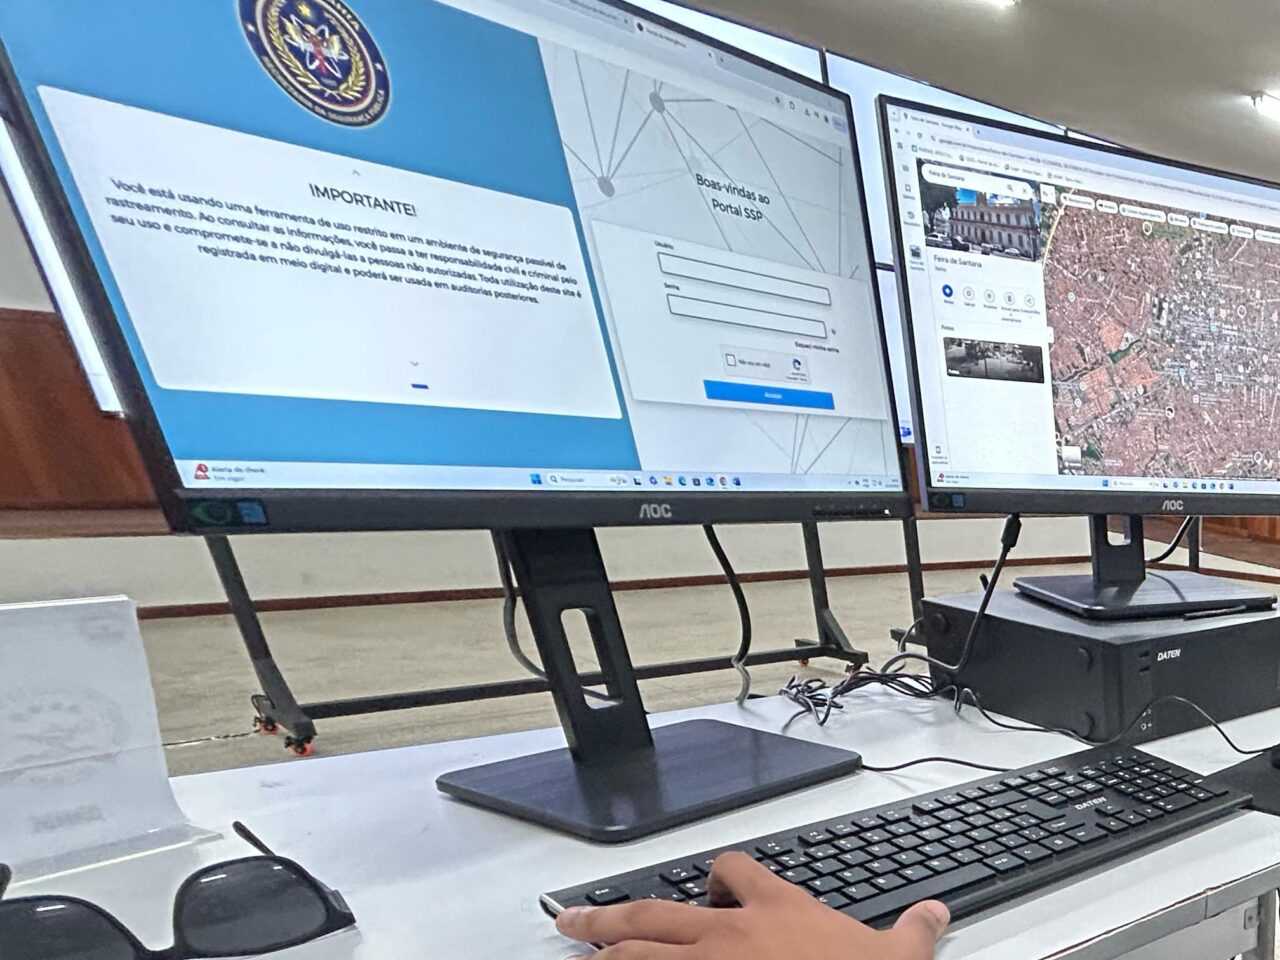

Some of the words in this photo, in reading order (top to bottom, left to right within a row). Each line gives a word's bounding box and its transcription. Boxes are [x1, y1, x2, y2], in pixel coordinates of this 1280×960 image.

[695, 172, 757, 202] Boas-vindas
[758, 193, 771, 206] ao
[308, 182, 418, 218] IMPORTANTE!
[711, 197, 743, 217] Portal
[743, 207, 763, 222] SSP
[639, 503, 673, 519] AOC
[1161, 499, 1184, 511] AOC
[1157, 648, 1182, 661] DATEN
[1074, 796, 1108, 811] DATEN
